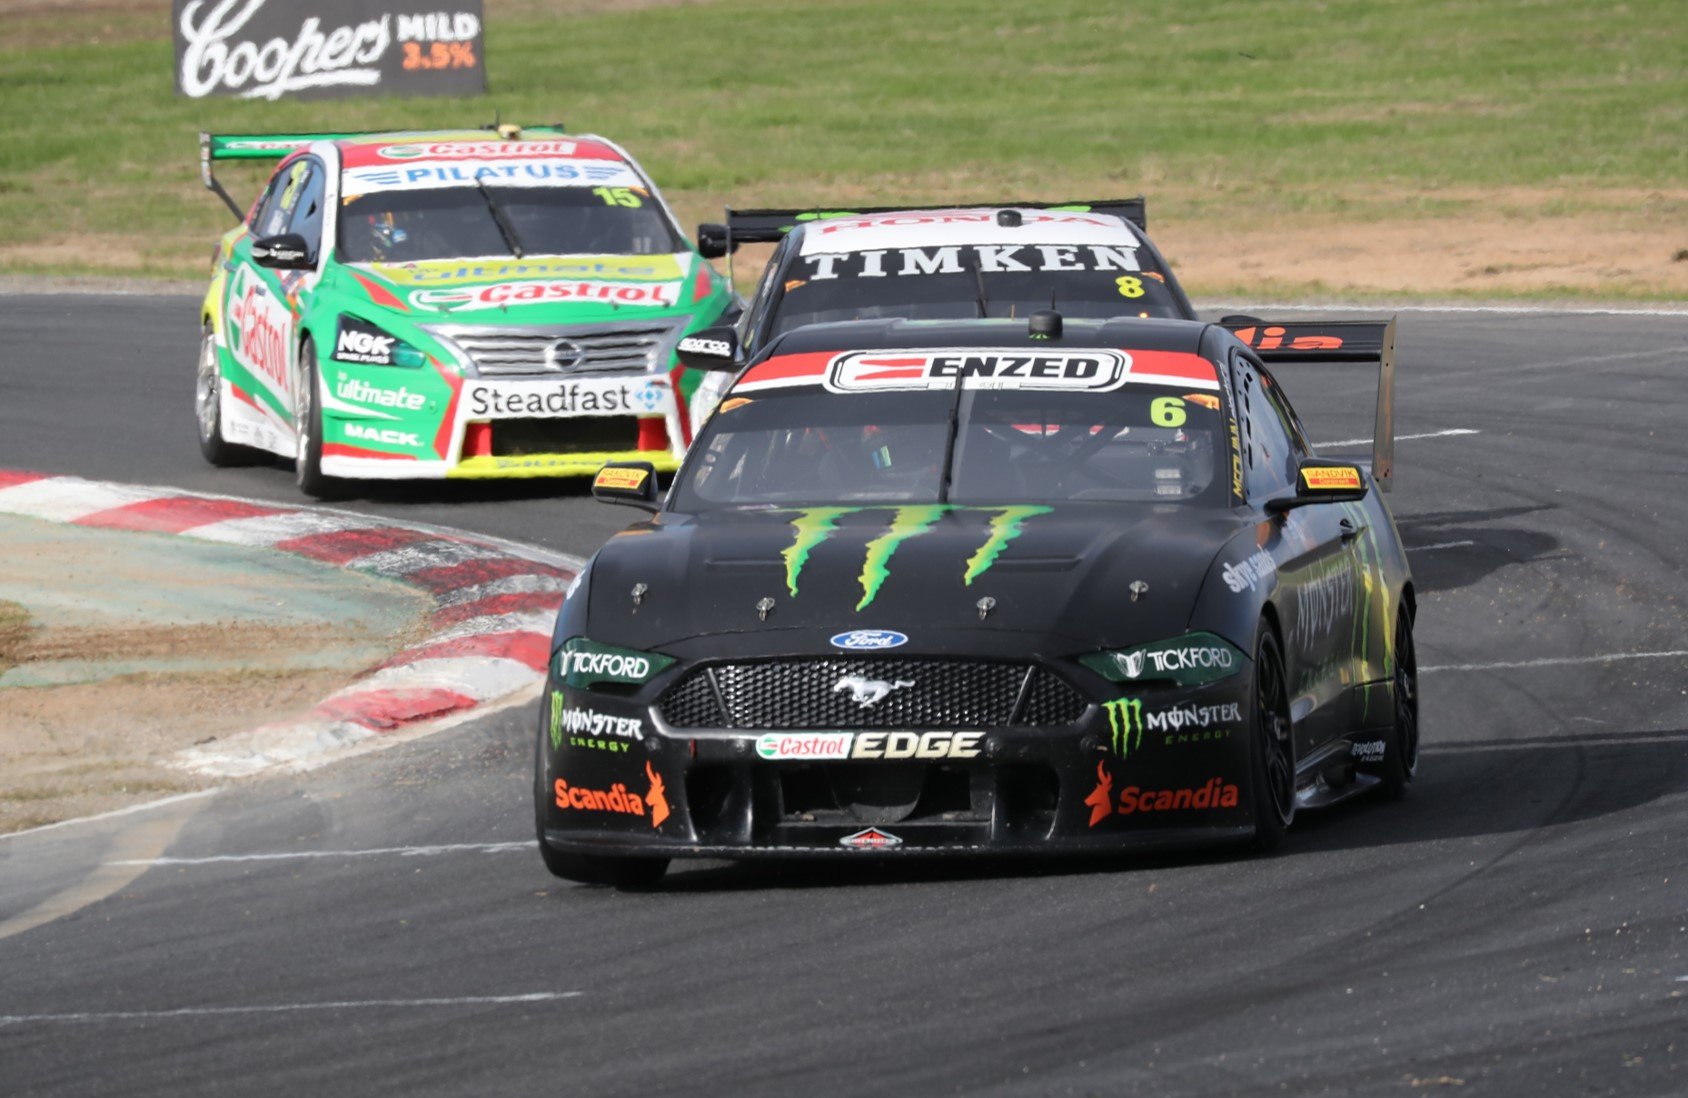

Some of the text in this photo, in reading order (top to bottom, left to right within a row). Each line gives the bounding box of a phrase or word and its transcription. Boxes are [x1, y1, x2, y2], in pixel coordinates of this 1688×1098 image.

[397, 12, 480, 42] MILD
[180, 0, 392, 100] Coopers
[402, 42, 476, 70] 3.5%
[428, 142, 563, 156] Castrol
[406, 165, 580, 183] PILATUS
[593, 187, 643, 208] 15
[805, 244, 1142, 281] TIMKEN
[479, 281, 672, 302] Castrol
[1115, 275, 1145, 298] 8
[338, 330, 396, 356] NGK
[928, 356, 1100, 379] ENZED
[336, 379, 427, 410] ultimate
[471, 384, 632, 415] Steadfast
[1150, 397, 1187, 428] 6
[344, 423, 419, 446] MACK
[844, 632, 894, 646] Ford
[573, 651, 650, 678] TICKFORD
[1147, 647, 1233, 671] TICKFORD
[570, 737, 630, 752] ENERGY
[780, 731, 986, 759] Castrol EDGE
[554, 778, 645, 816] Scandia
[1117, 777, 1240, 814] Scandia
